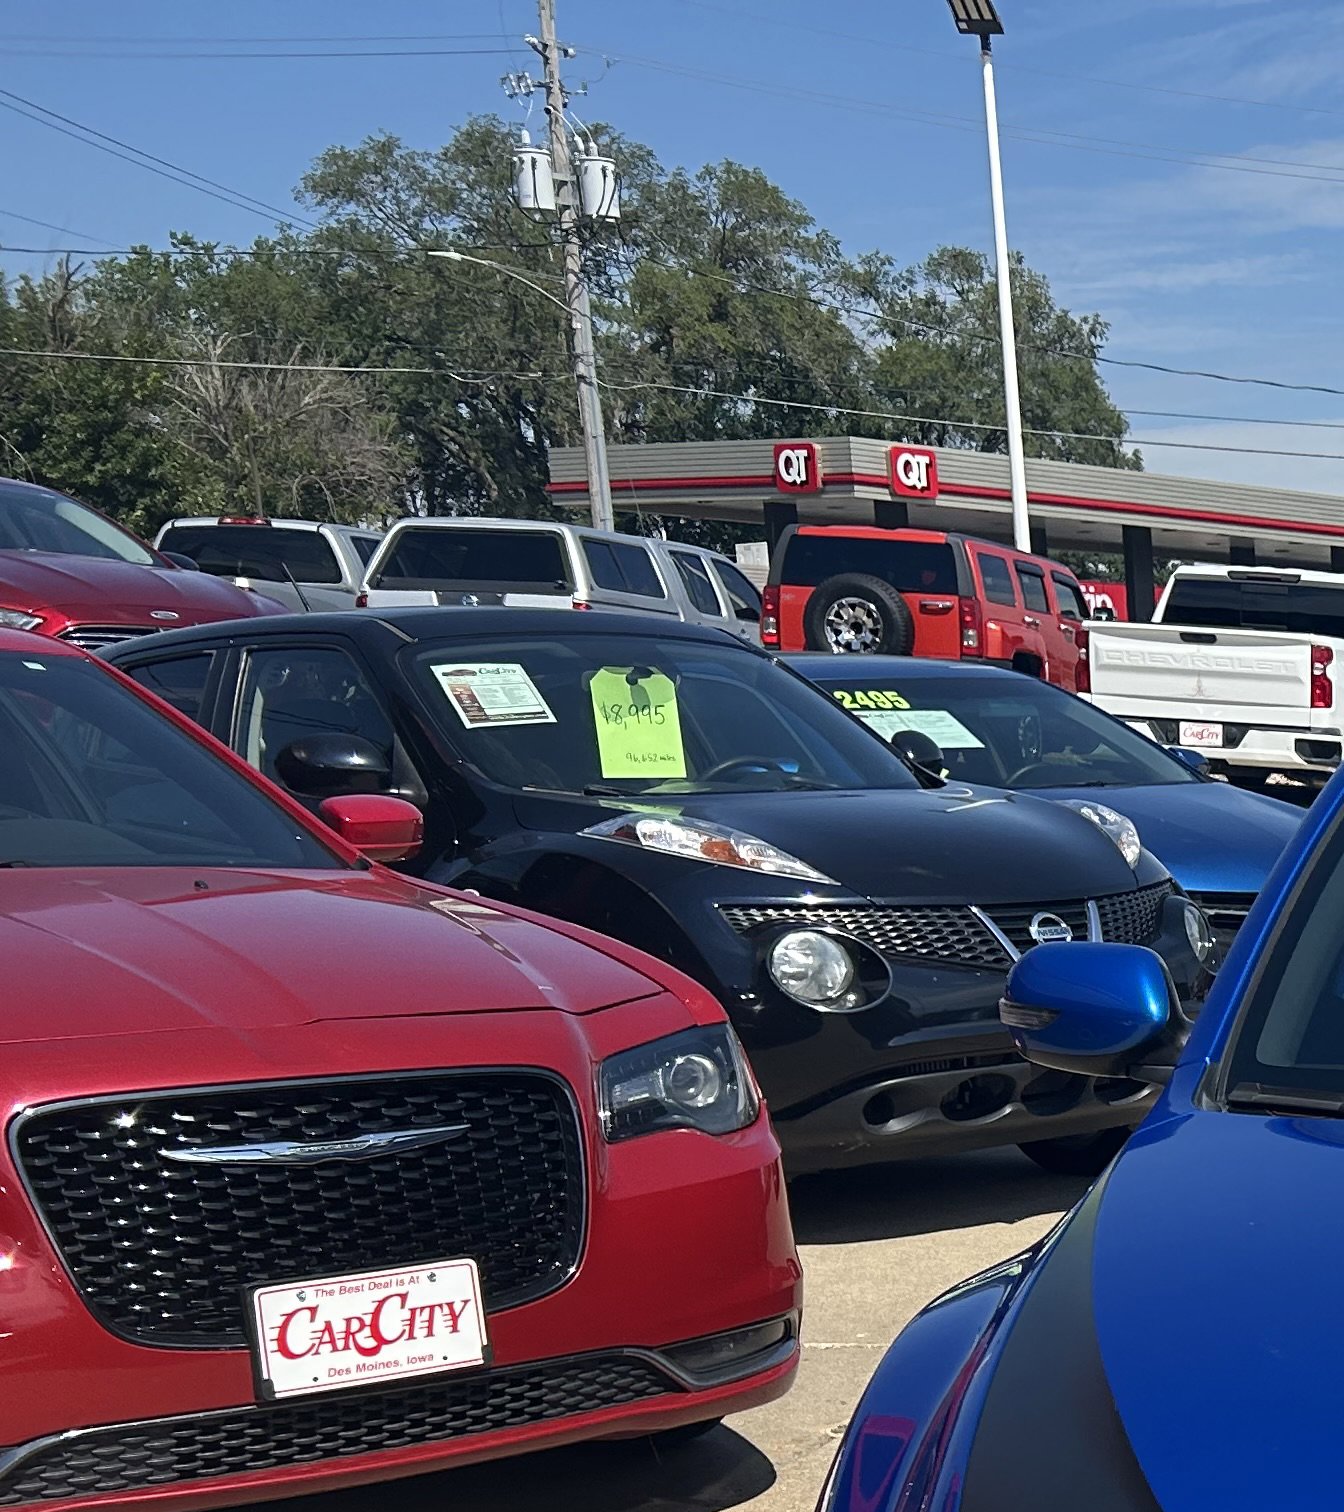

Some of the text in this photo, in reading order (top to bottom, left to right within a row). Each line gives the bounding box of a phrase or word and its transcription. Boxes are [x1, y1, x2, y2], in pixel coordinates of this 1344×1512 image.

[778, 449, 808, 485] QT
[896, 453, 930, 490] QT
[1102, 650, 1296, 674] CHEVROLET
[314, 1288, 335, 1298] The
[339, 1284, 365, 1295] Best
[368, 1279, 393, 1291] Deal
[408, 1275, 420, 1285] At
[328, 1367, 351, 1377] Des
[407, 1354, 434, 1364] Iowa
